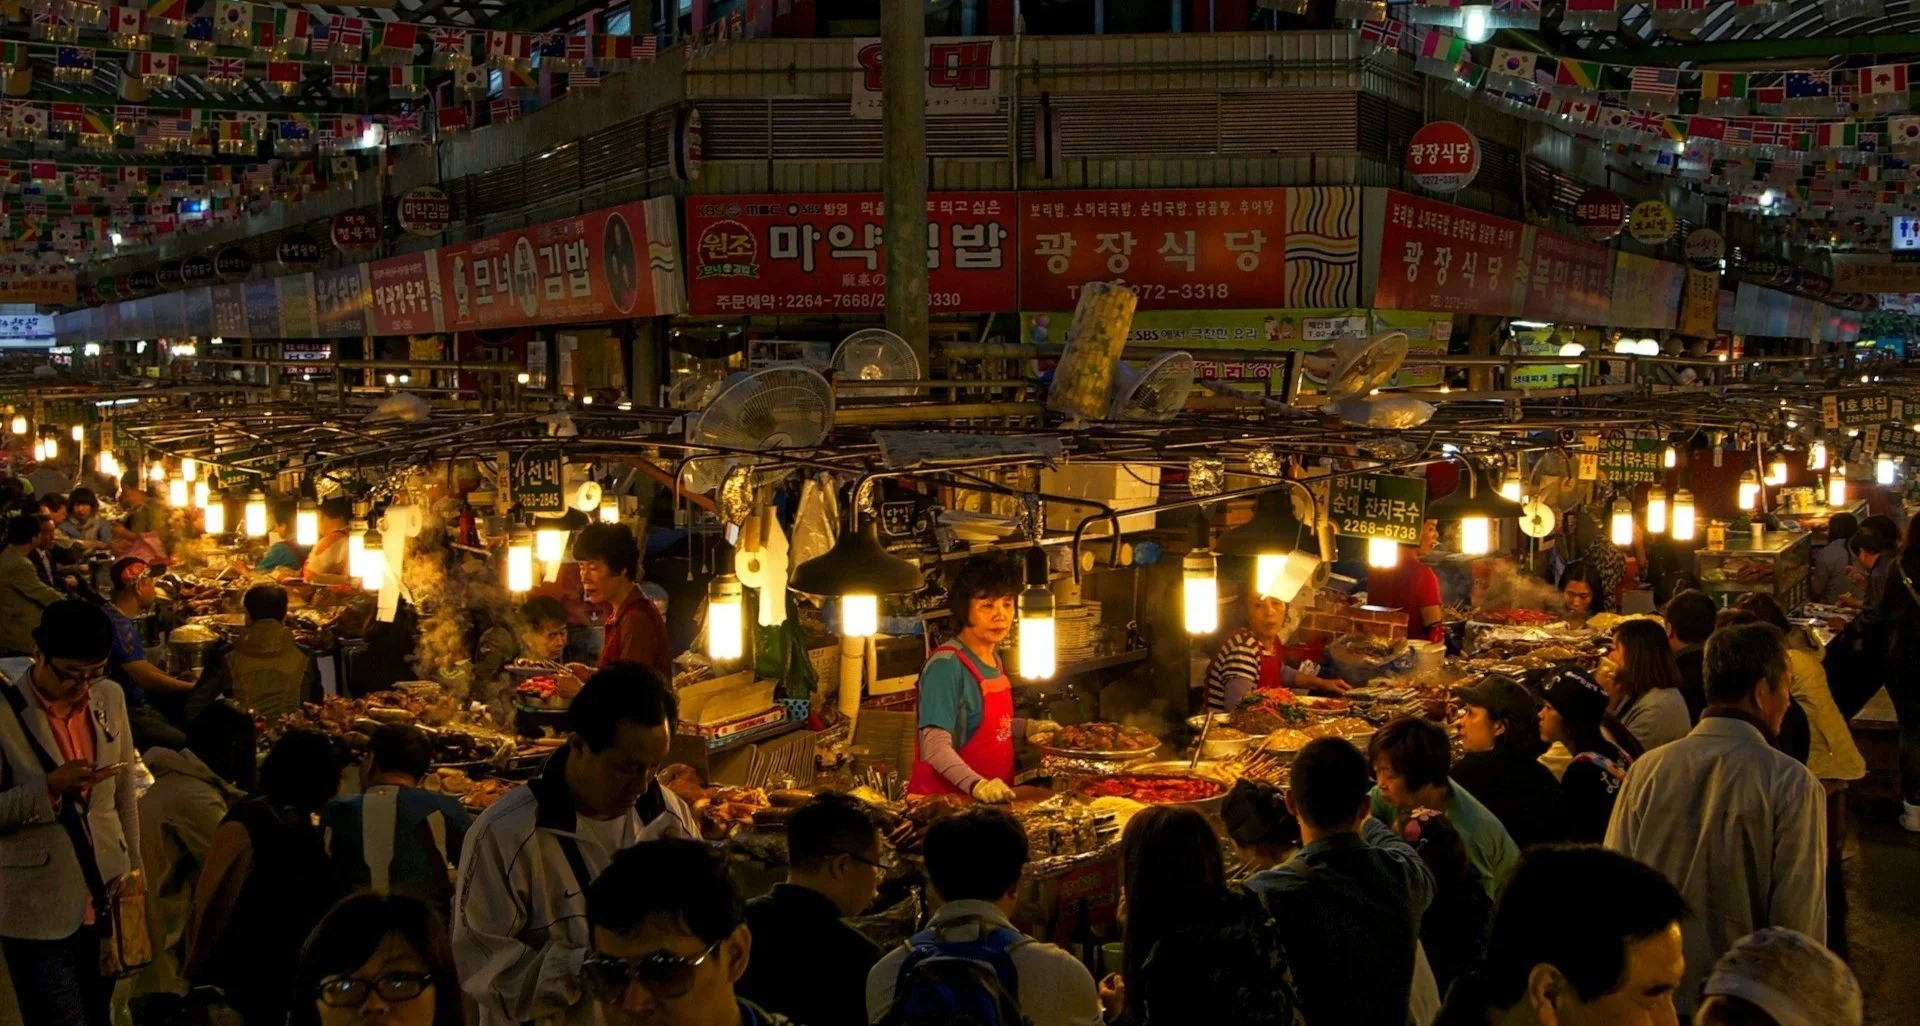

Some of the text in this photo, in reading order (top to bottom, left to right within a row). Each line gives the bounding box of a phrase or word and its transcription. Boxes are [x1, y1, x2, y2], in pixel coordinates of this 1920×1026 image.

[1411, 143, 1472, 165] 광장식당
[824, 203, 848, 217] 방영
[939, 202, 968, 215] 먹고
[973, 201, 1001, 216] 싶은
[1240, 200, 1274, 221] 추어탕
[703, 233, 753, 260] 원조
[1336, 476, 1377, 493] 하니네
[1333, 493, 1421, 524] 순대 잔치국수
[1343, 519, 1417, 540] 2268-6738
